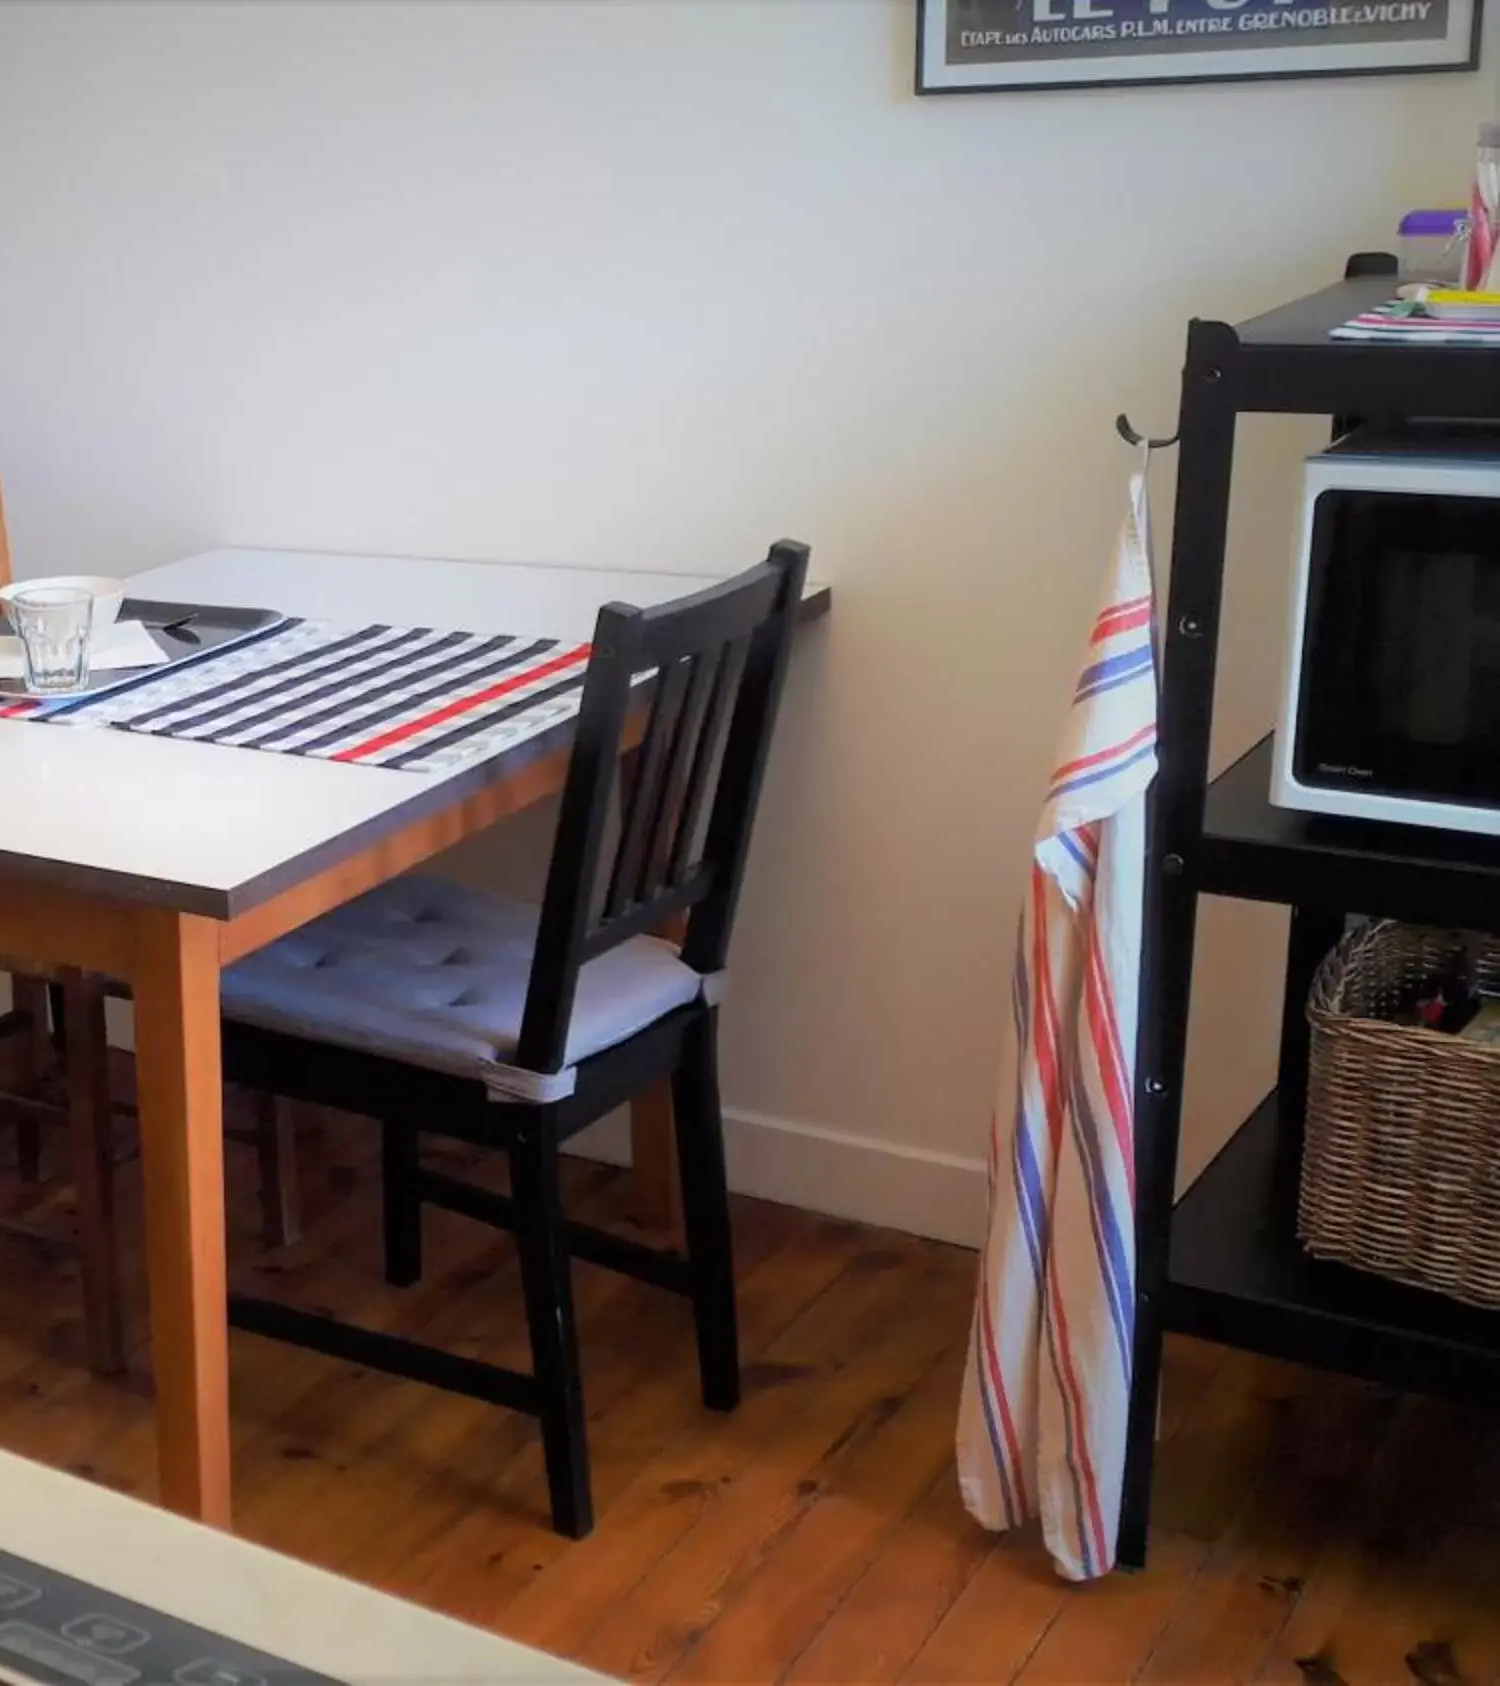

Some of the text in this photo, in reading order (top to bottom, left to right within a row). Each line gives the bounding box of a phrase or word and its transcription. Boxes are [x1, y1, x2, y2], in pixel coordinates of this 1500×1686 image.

[1031, 24, 1116, 43] AUTOCARS
[1120, 20, 1173, 38] P.L.M.
[1176, 16, 1233, 35] ENTRE
[1238, 5, 1349, 31] GRENOBLE
[1364, 2, 1432, 22] VICHY
